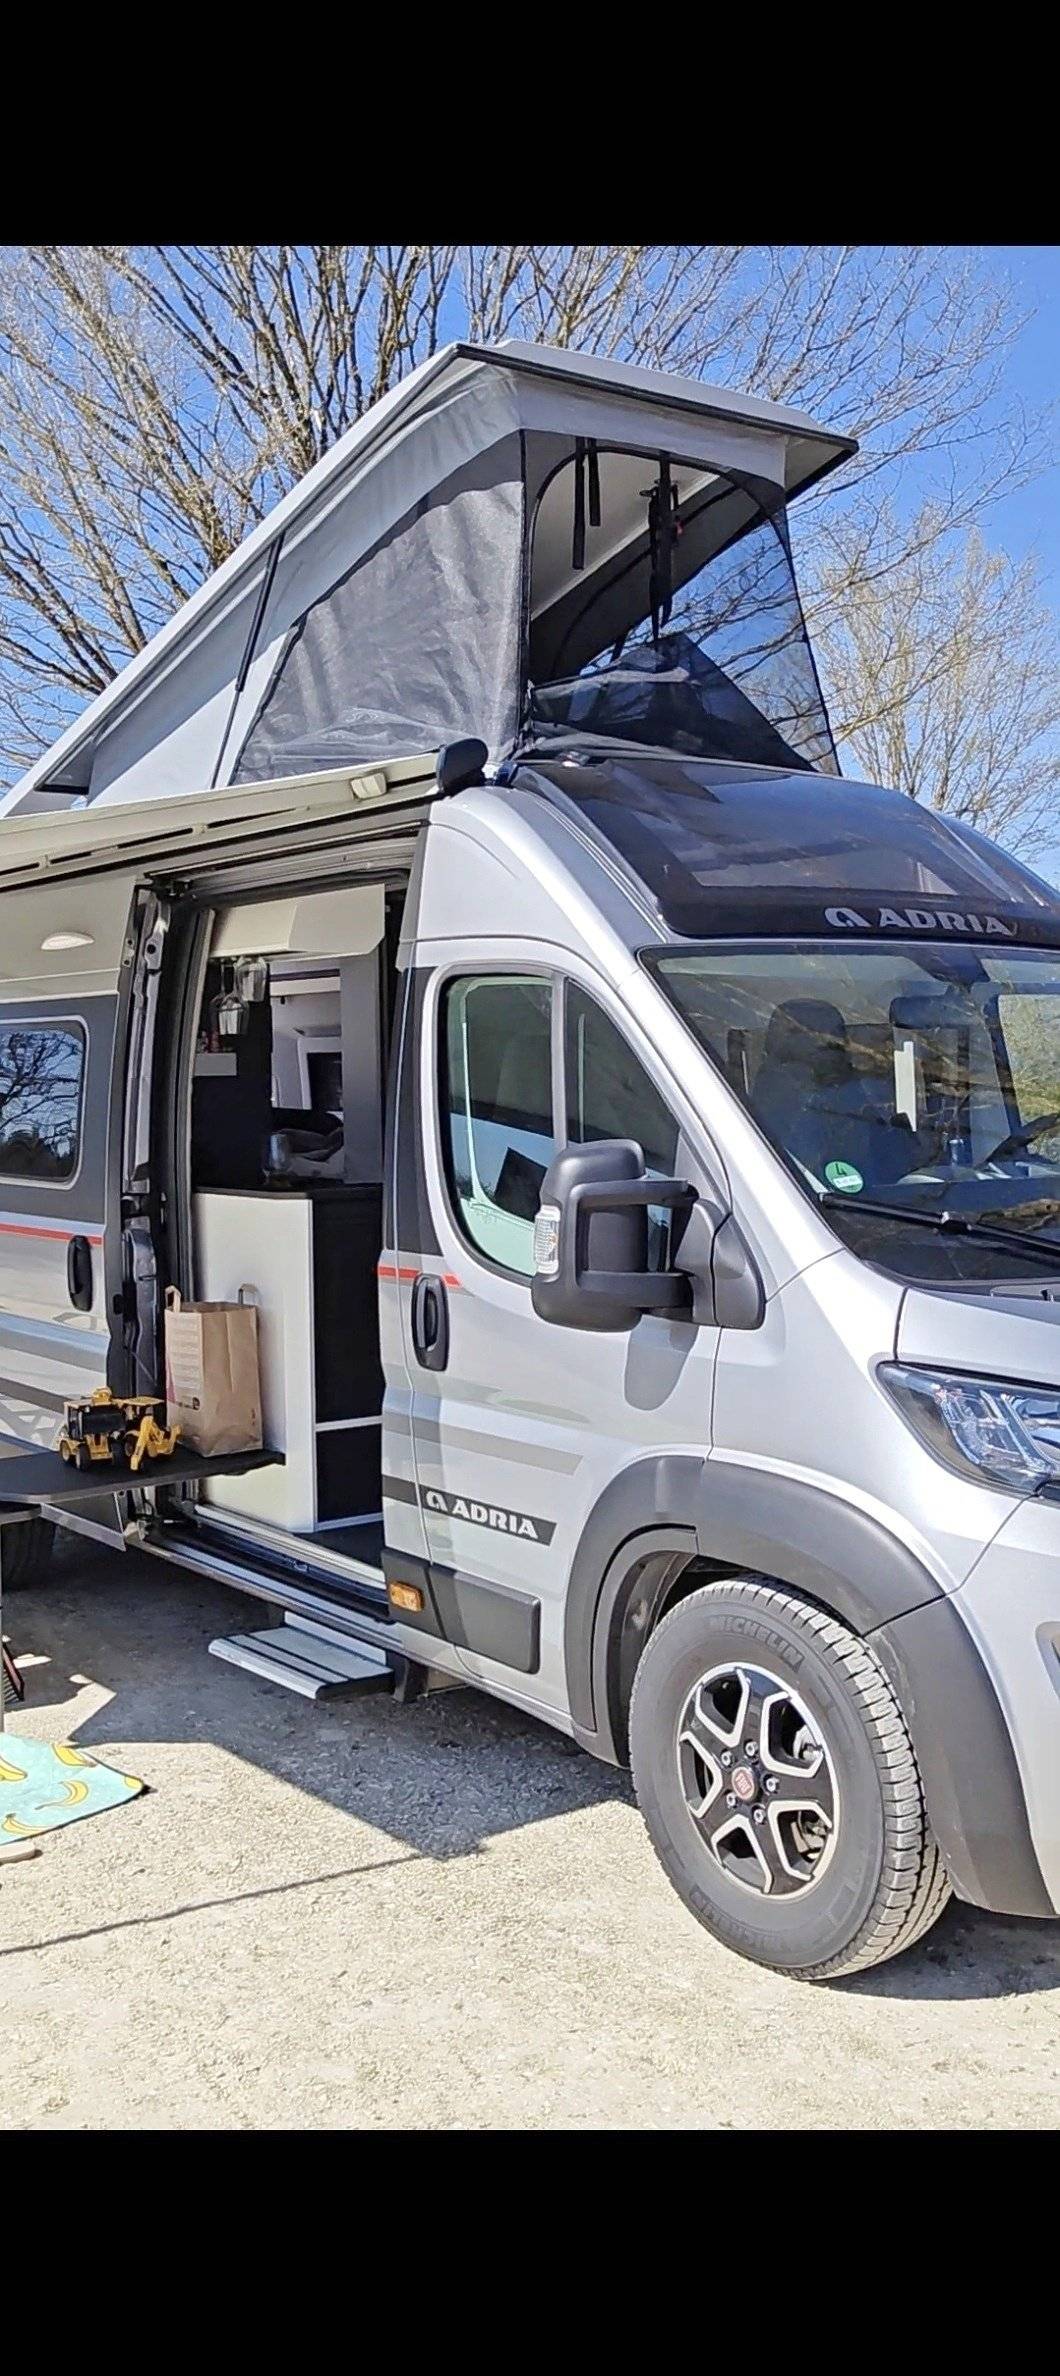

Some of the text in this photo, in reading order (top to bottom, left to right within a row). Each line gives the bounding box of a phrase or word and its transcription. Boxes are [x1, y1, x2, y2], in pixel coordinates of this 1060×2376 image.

[878, 907, 1015, 937] ADRIA
[834, 1162, 848, 1177] 4
[452, 1498, 539, 1540] ADRIA
